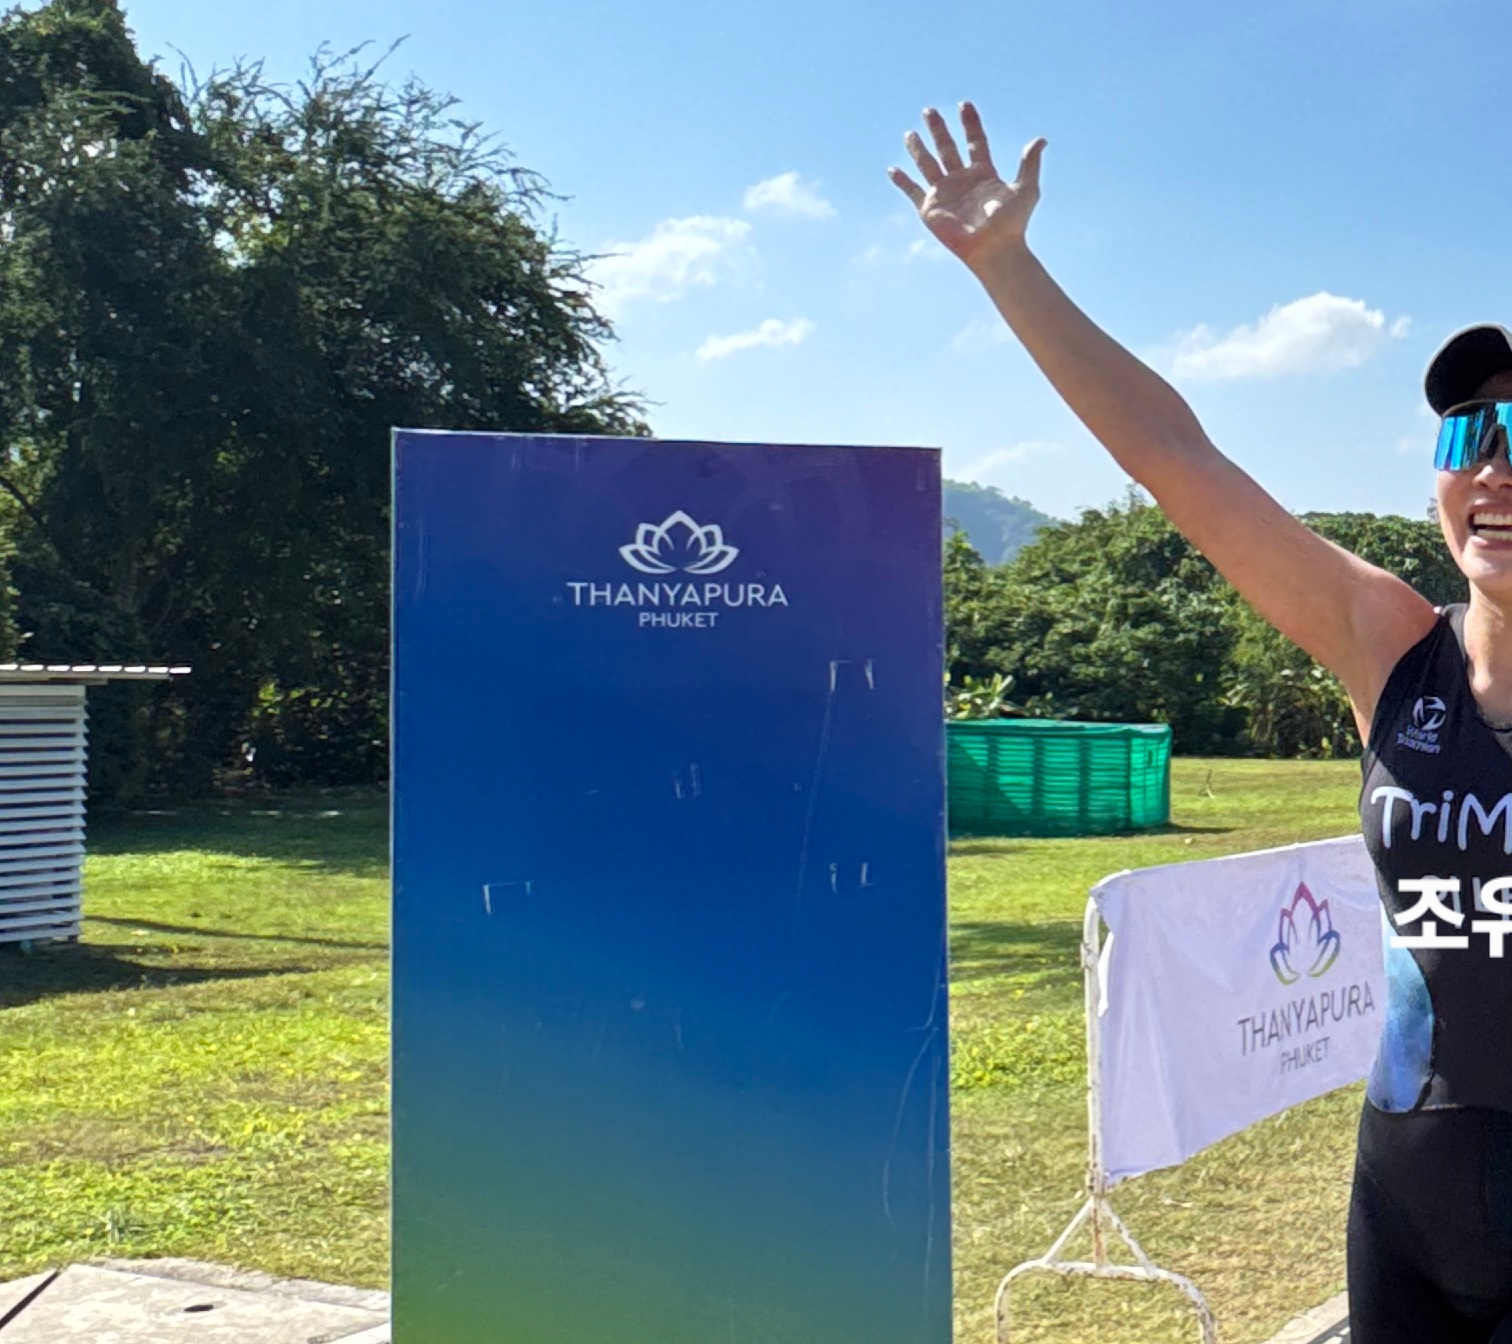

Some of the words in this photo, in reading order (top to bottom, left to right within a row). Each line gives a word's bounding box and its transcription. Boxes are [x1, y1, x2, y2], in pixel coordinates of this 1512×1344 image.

[566, 581, 789, 607] THANYAPURA
[638, 612, 719, 628] PHUKET
[1237, 981, 1375, 1056] THANYAPURA
[1280, 1036, 1330, 1075] PHUKET
